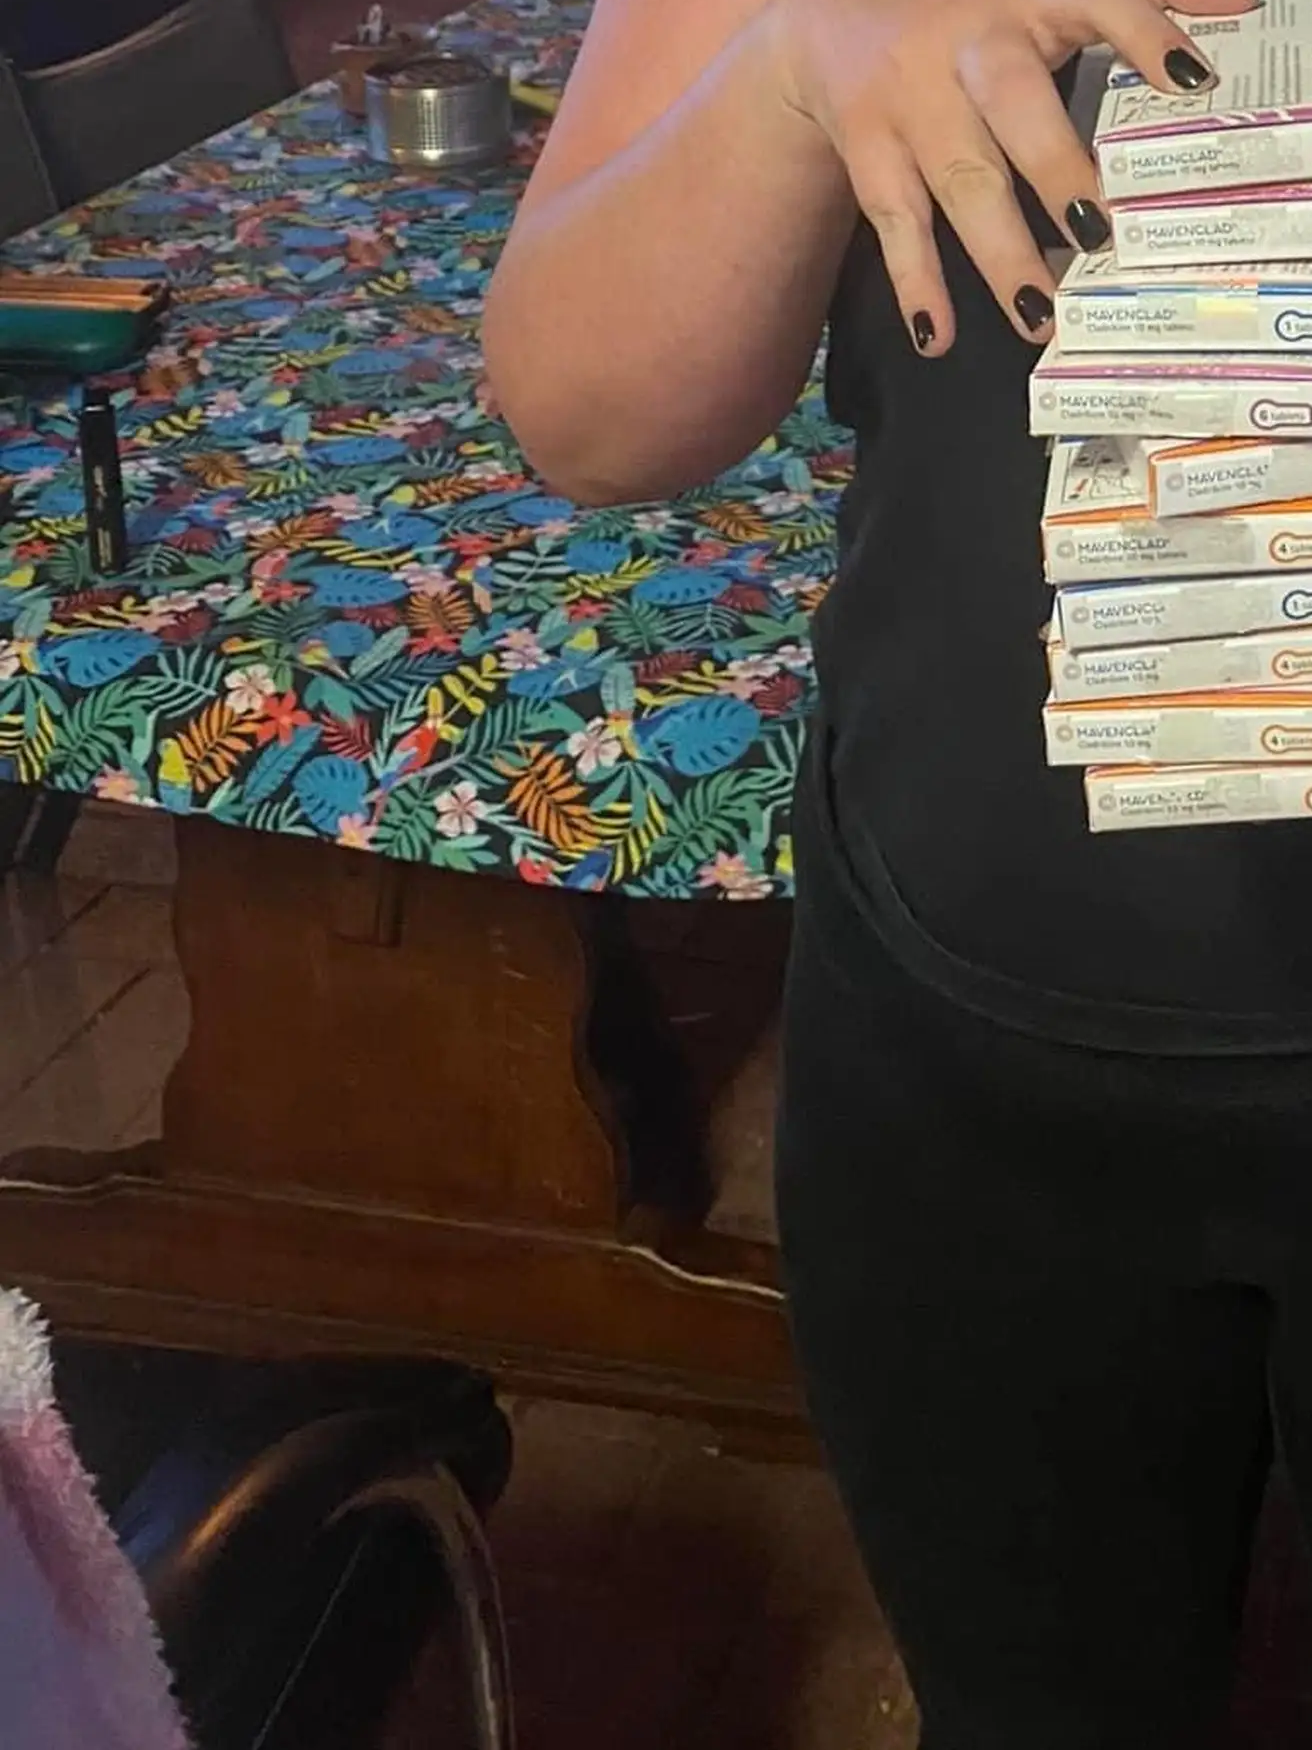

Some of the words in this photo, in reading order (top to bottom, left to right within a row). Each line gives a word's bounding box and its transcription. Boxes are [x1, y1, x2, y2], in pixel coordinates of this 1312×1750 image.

[1132, 149, 1218, 168] MAVENCLAD
[1147, 221, 1233, 238] MAVENCLAD
[1087, 308, 1173, 321] MAVENCLAD
[1078, 538, 1166, 553] MAVENCLAD
[1278, 544, 1287, 554] 4
[1281, 659, 1289, 670] 4
[1271, 736, 1279, 746] 4
